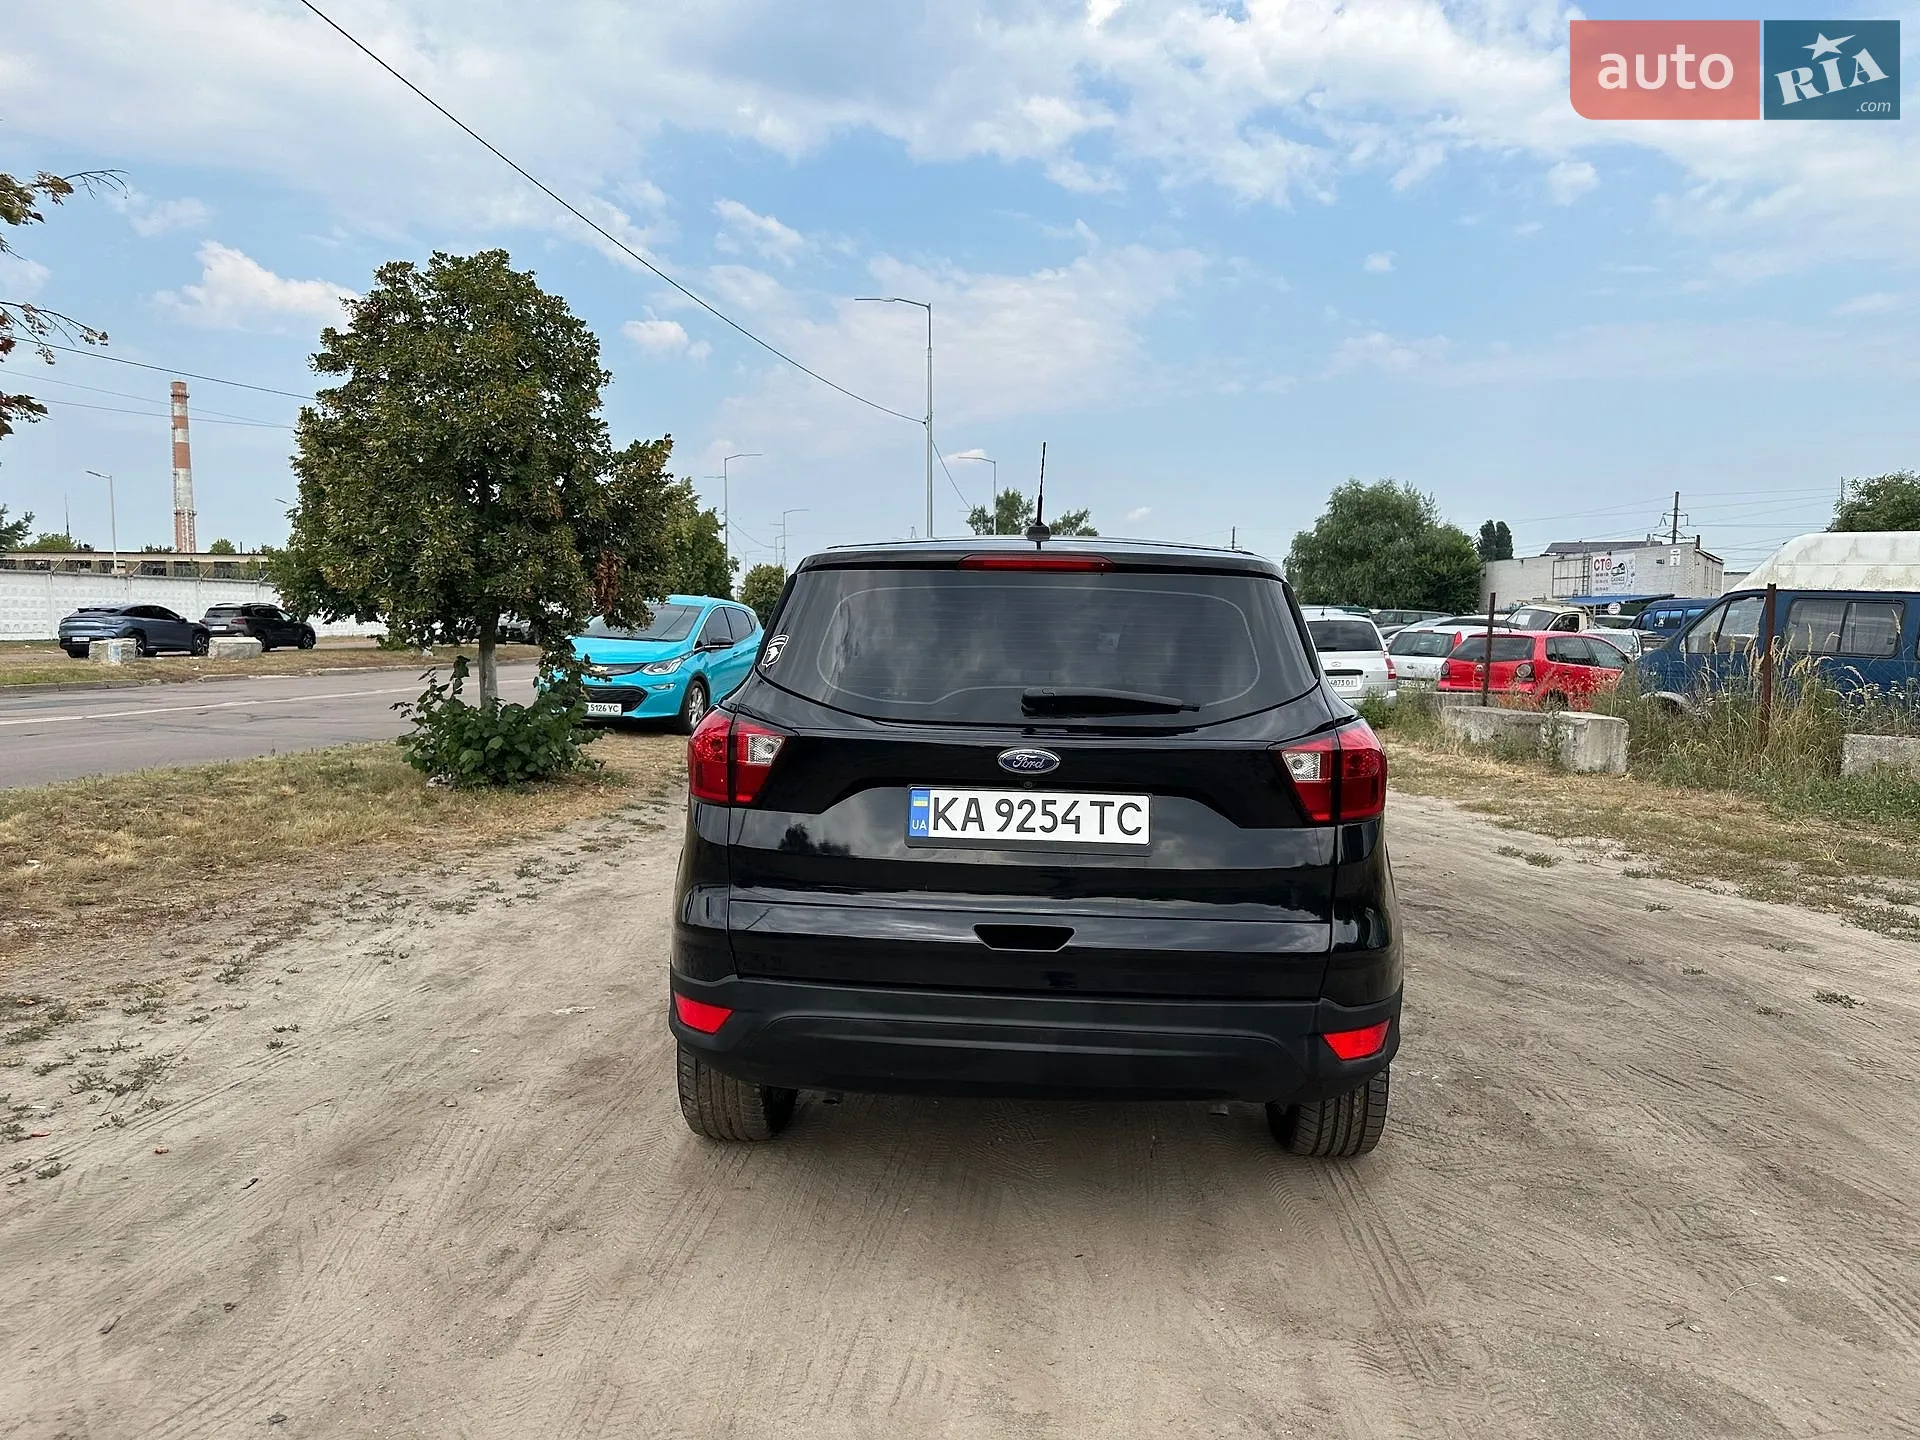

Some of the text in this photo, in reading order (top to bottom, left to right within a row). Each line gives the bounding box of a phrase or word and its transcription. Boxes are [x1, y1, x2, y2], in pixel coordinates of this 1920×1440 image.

[1012, 754, 1045, 769] Ford
[932, 797, 1143, 836] KA 9254 TC
[912, 819, 928, 831] UA
